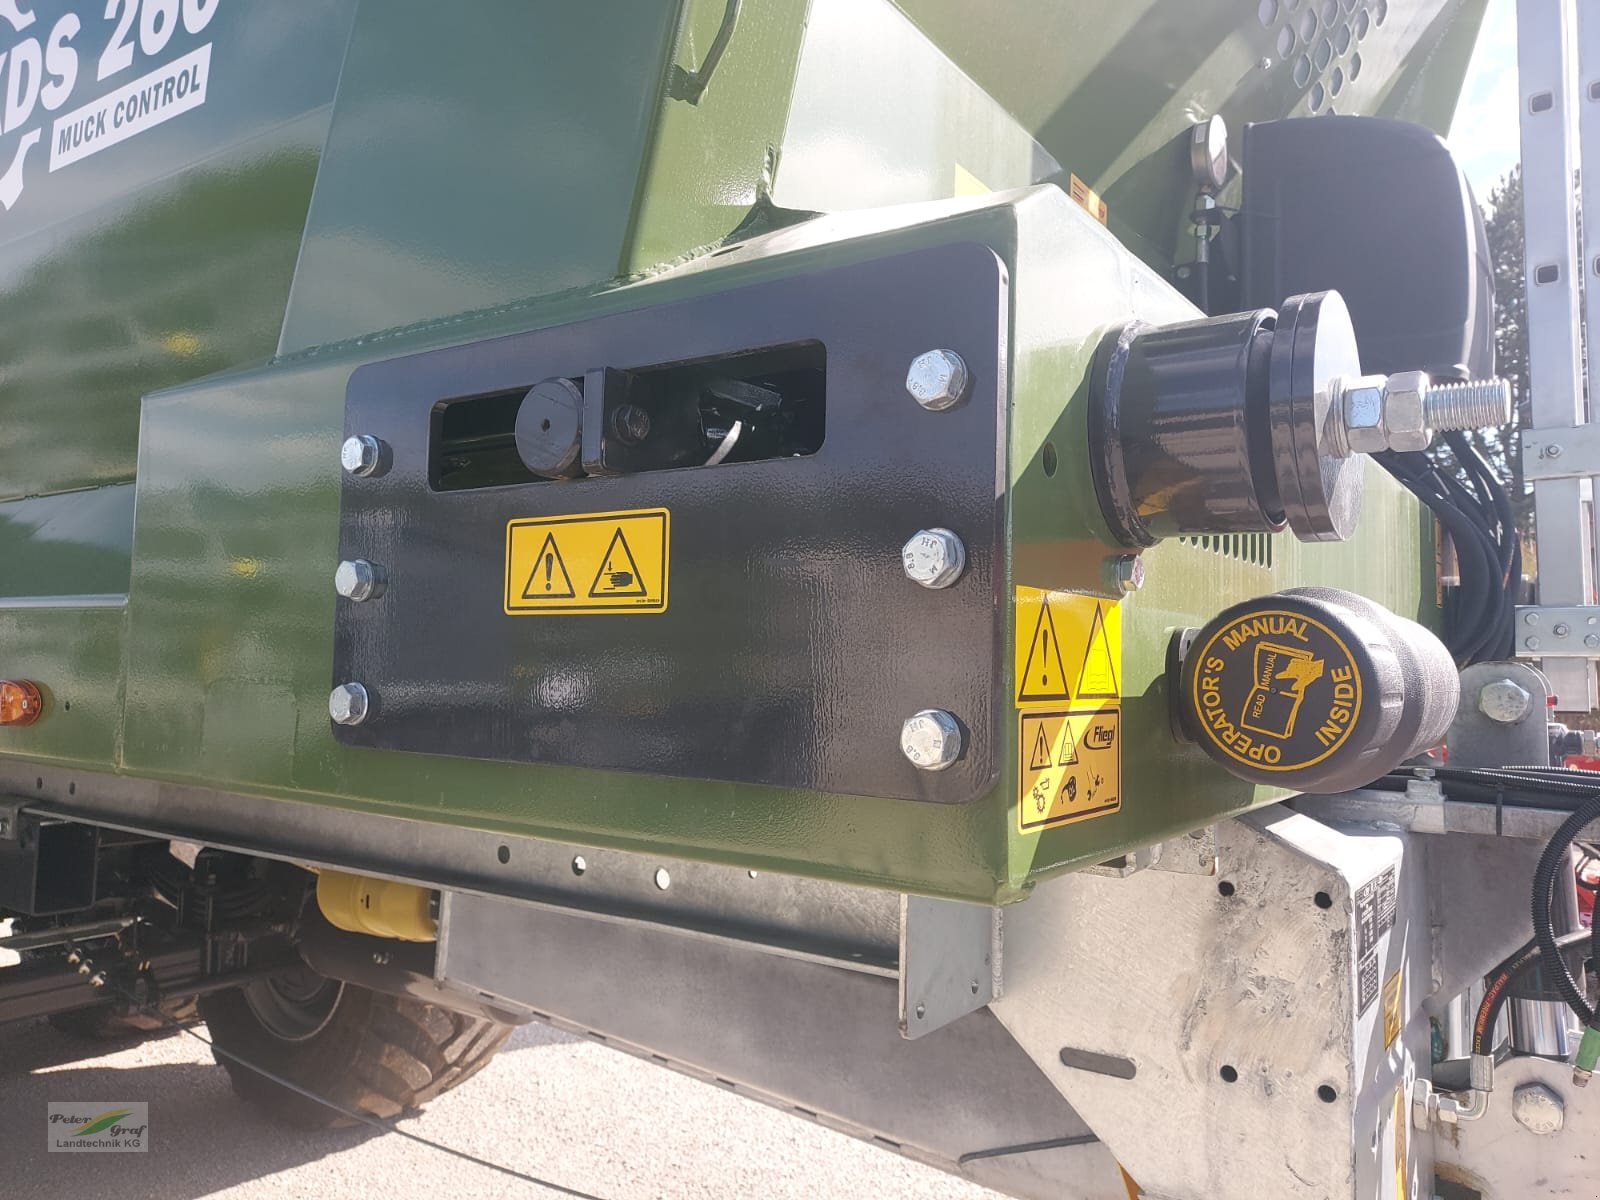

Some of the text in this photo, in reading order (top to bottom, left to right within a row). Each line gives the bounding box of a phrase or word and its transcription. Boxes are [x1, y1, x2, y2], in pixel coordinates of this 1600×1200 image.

[57, 64, 201, 156] MUCK CONTROL
[1202, 615, 1354, 764] OPERATOR'S MANUAL INSIDE
[1252, 651, 1278, 719] READ MANUAL
[1093, 723, 1116, 746] Fliegl
